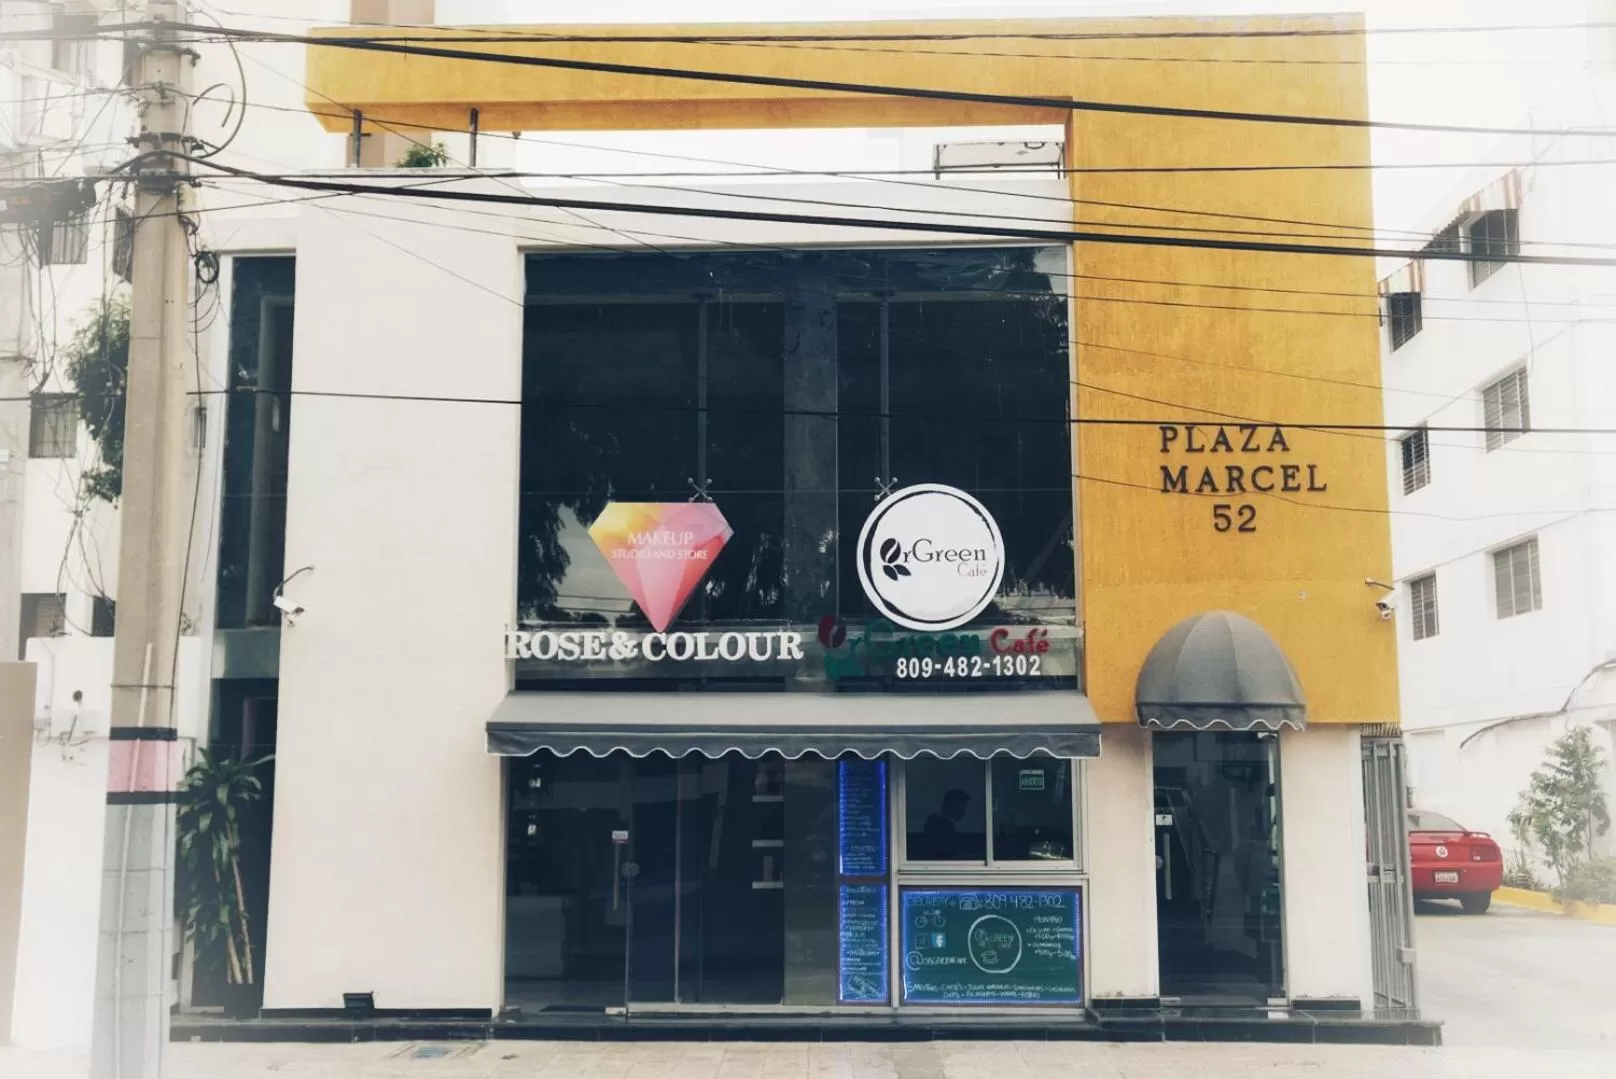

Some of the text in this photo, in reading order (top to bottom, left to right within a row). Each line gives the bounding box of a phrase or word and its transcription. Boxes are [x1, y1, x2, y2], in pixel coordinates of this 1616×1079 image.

[1158, 424, 1291, 453] PLAZA
[1159, 464, 1328, 494] MARCEL
[1212, 503, 1257, 533] 52
[627, 530, 695, 546] MAKEUP
[651, 548, 675, 561] AND
[676, 548, 709, 561] STORE
[989, 626, 1051, 655] Café
[896, 654, 1042, 679] 809-482-1302
